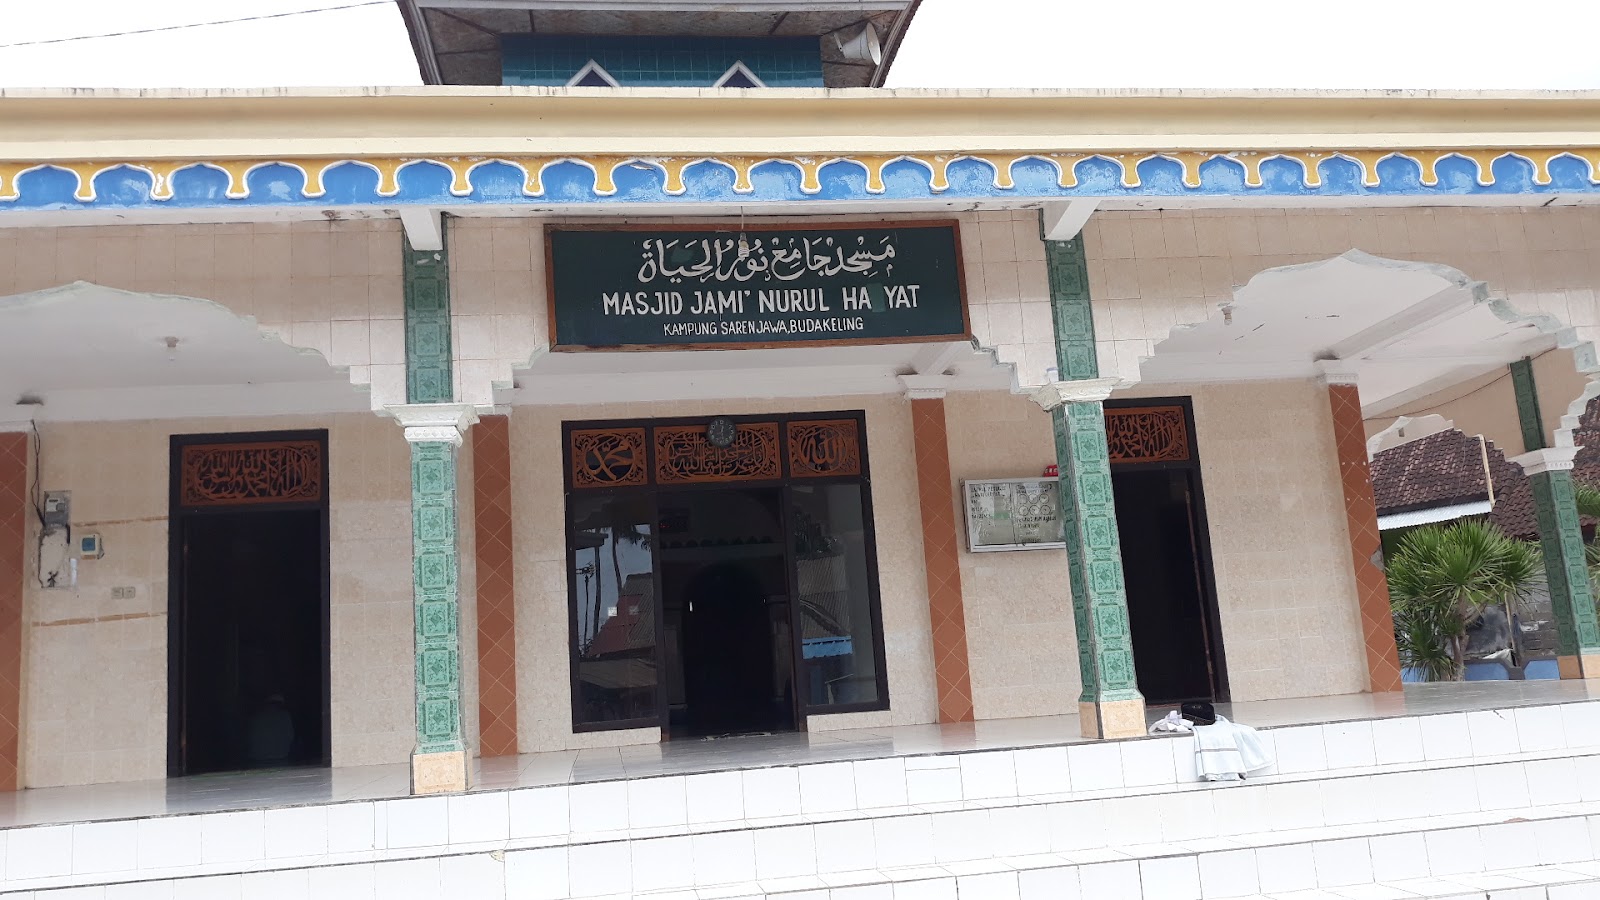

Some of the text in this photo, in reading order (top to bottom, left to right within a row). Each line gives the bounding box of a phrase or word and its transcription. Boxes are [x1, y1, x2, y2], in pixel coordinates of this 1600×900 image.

[602, 291, 684, 316] MASJID
[758, 287, 830, 314] NURUL
[663, 321, 718, 337] KAMPUNG
